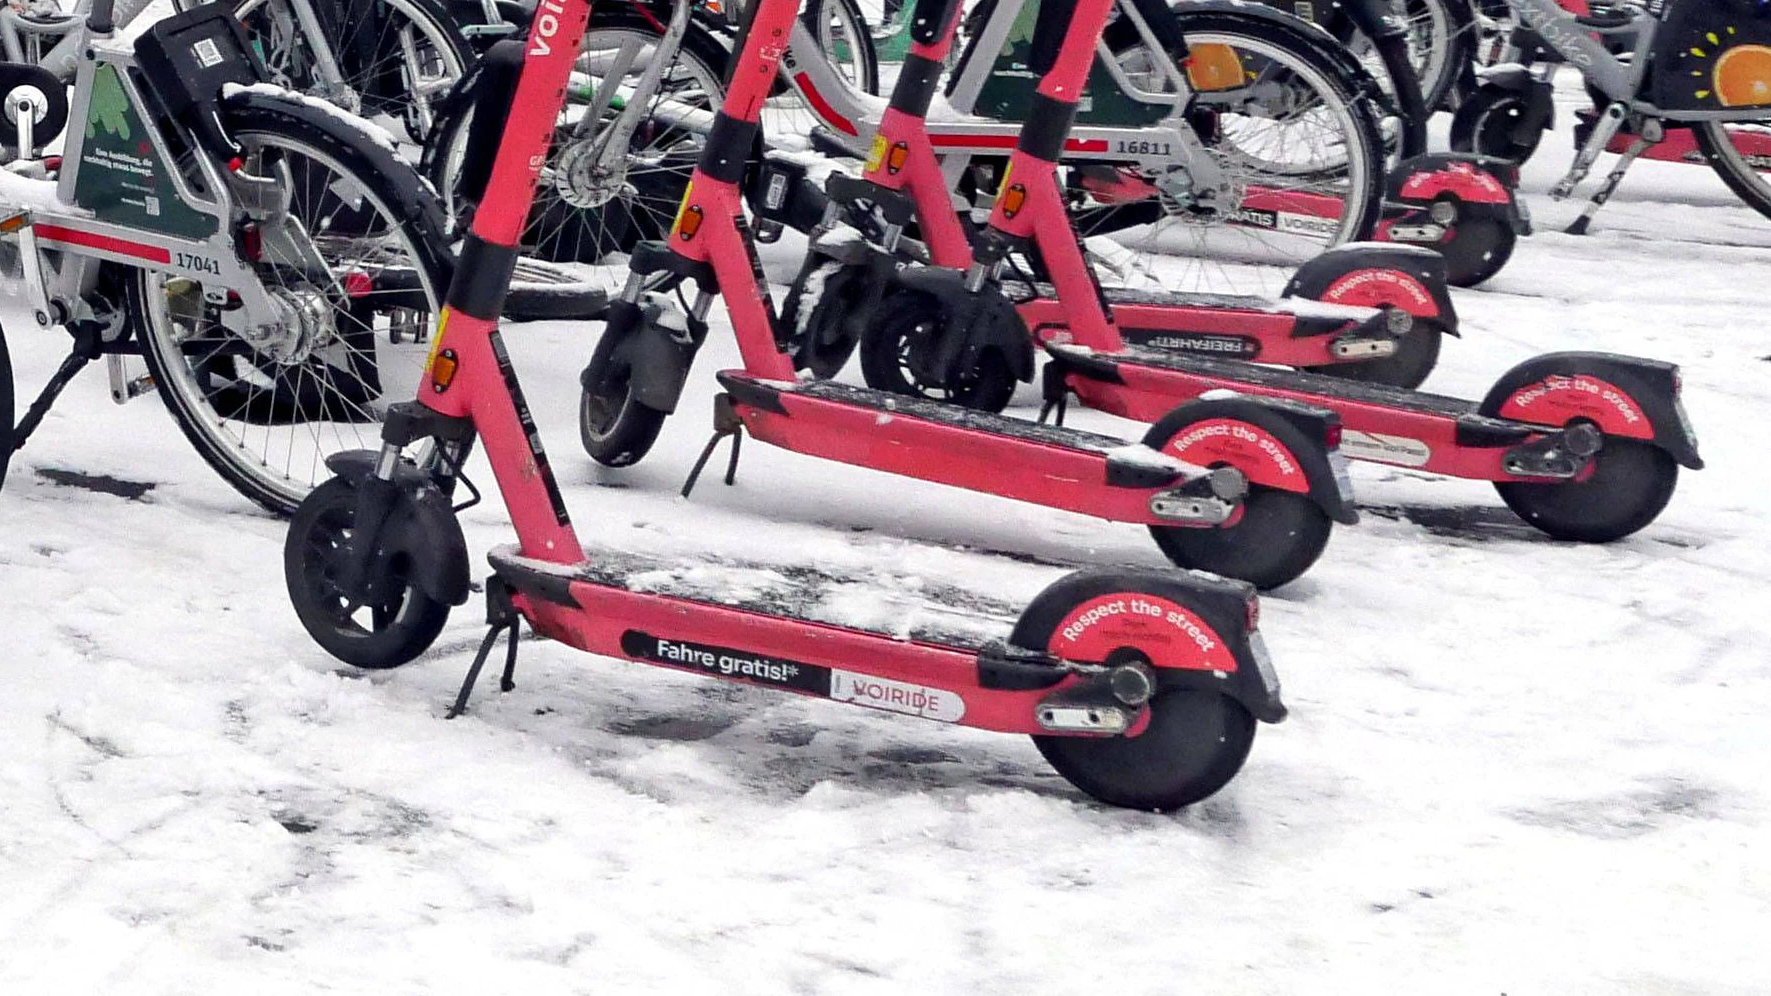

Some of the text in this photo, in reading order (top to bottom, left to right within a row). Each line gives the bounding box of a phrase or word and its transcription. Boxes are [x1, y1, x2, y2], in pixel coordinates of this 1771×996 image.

[1116, 140, 1172, 156] 16811
[177, 253, 221, 275] 17041
[1331, 272, 1374, 299] Respect
[1375, 272, 1397, 283] the
[1574, 380, 1599, 394] the
[1174, 425, 1229, 452] Respect
[1232, 426, 1258, 442] the
[1258, 439, 1294, 475] street
[1062, 600, 1127, 642] Respect
[1130, 599, 1162, 616] the
[1166, 610, 1216, 652] street
[657, 639, 715, 668] Fahre
[852, 679, 939, 712] VOIRIDE
